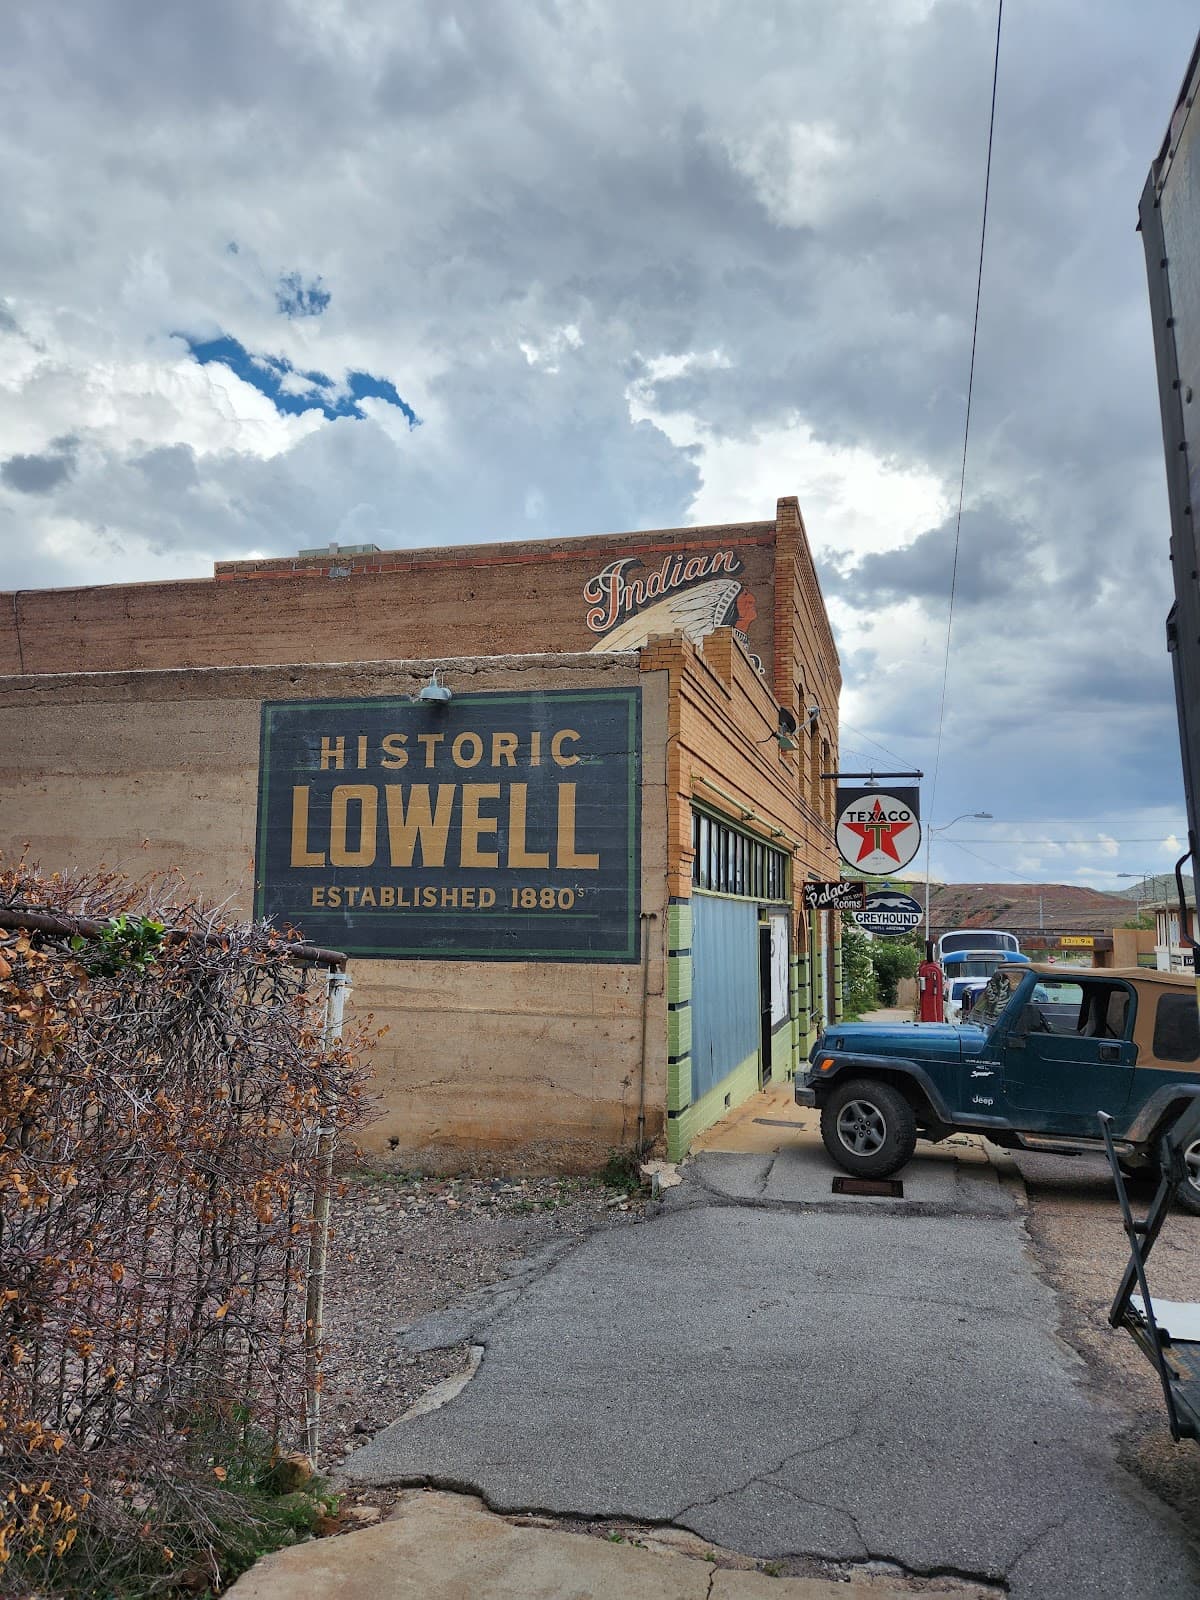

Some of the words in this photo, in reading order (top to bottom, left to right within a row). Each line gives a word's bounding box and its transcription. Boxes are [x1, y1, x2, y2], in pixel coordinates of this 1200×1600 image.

[583, 550, 740, 632] Indian
[319, 729, 583, 770] HISTORIC
[289, 782, 600, 870] LOWELL
[847, 811, 910, 822] TEXACO
[311, 886, 497, 910] ESTABLISHED
[805, 881, 856, 910] Palace
[856, 913, 919, 924] GREYHOUND
[972, 1095, 994, 1106] Jeep
